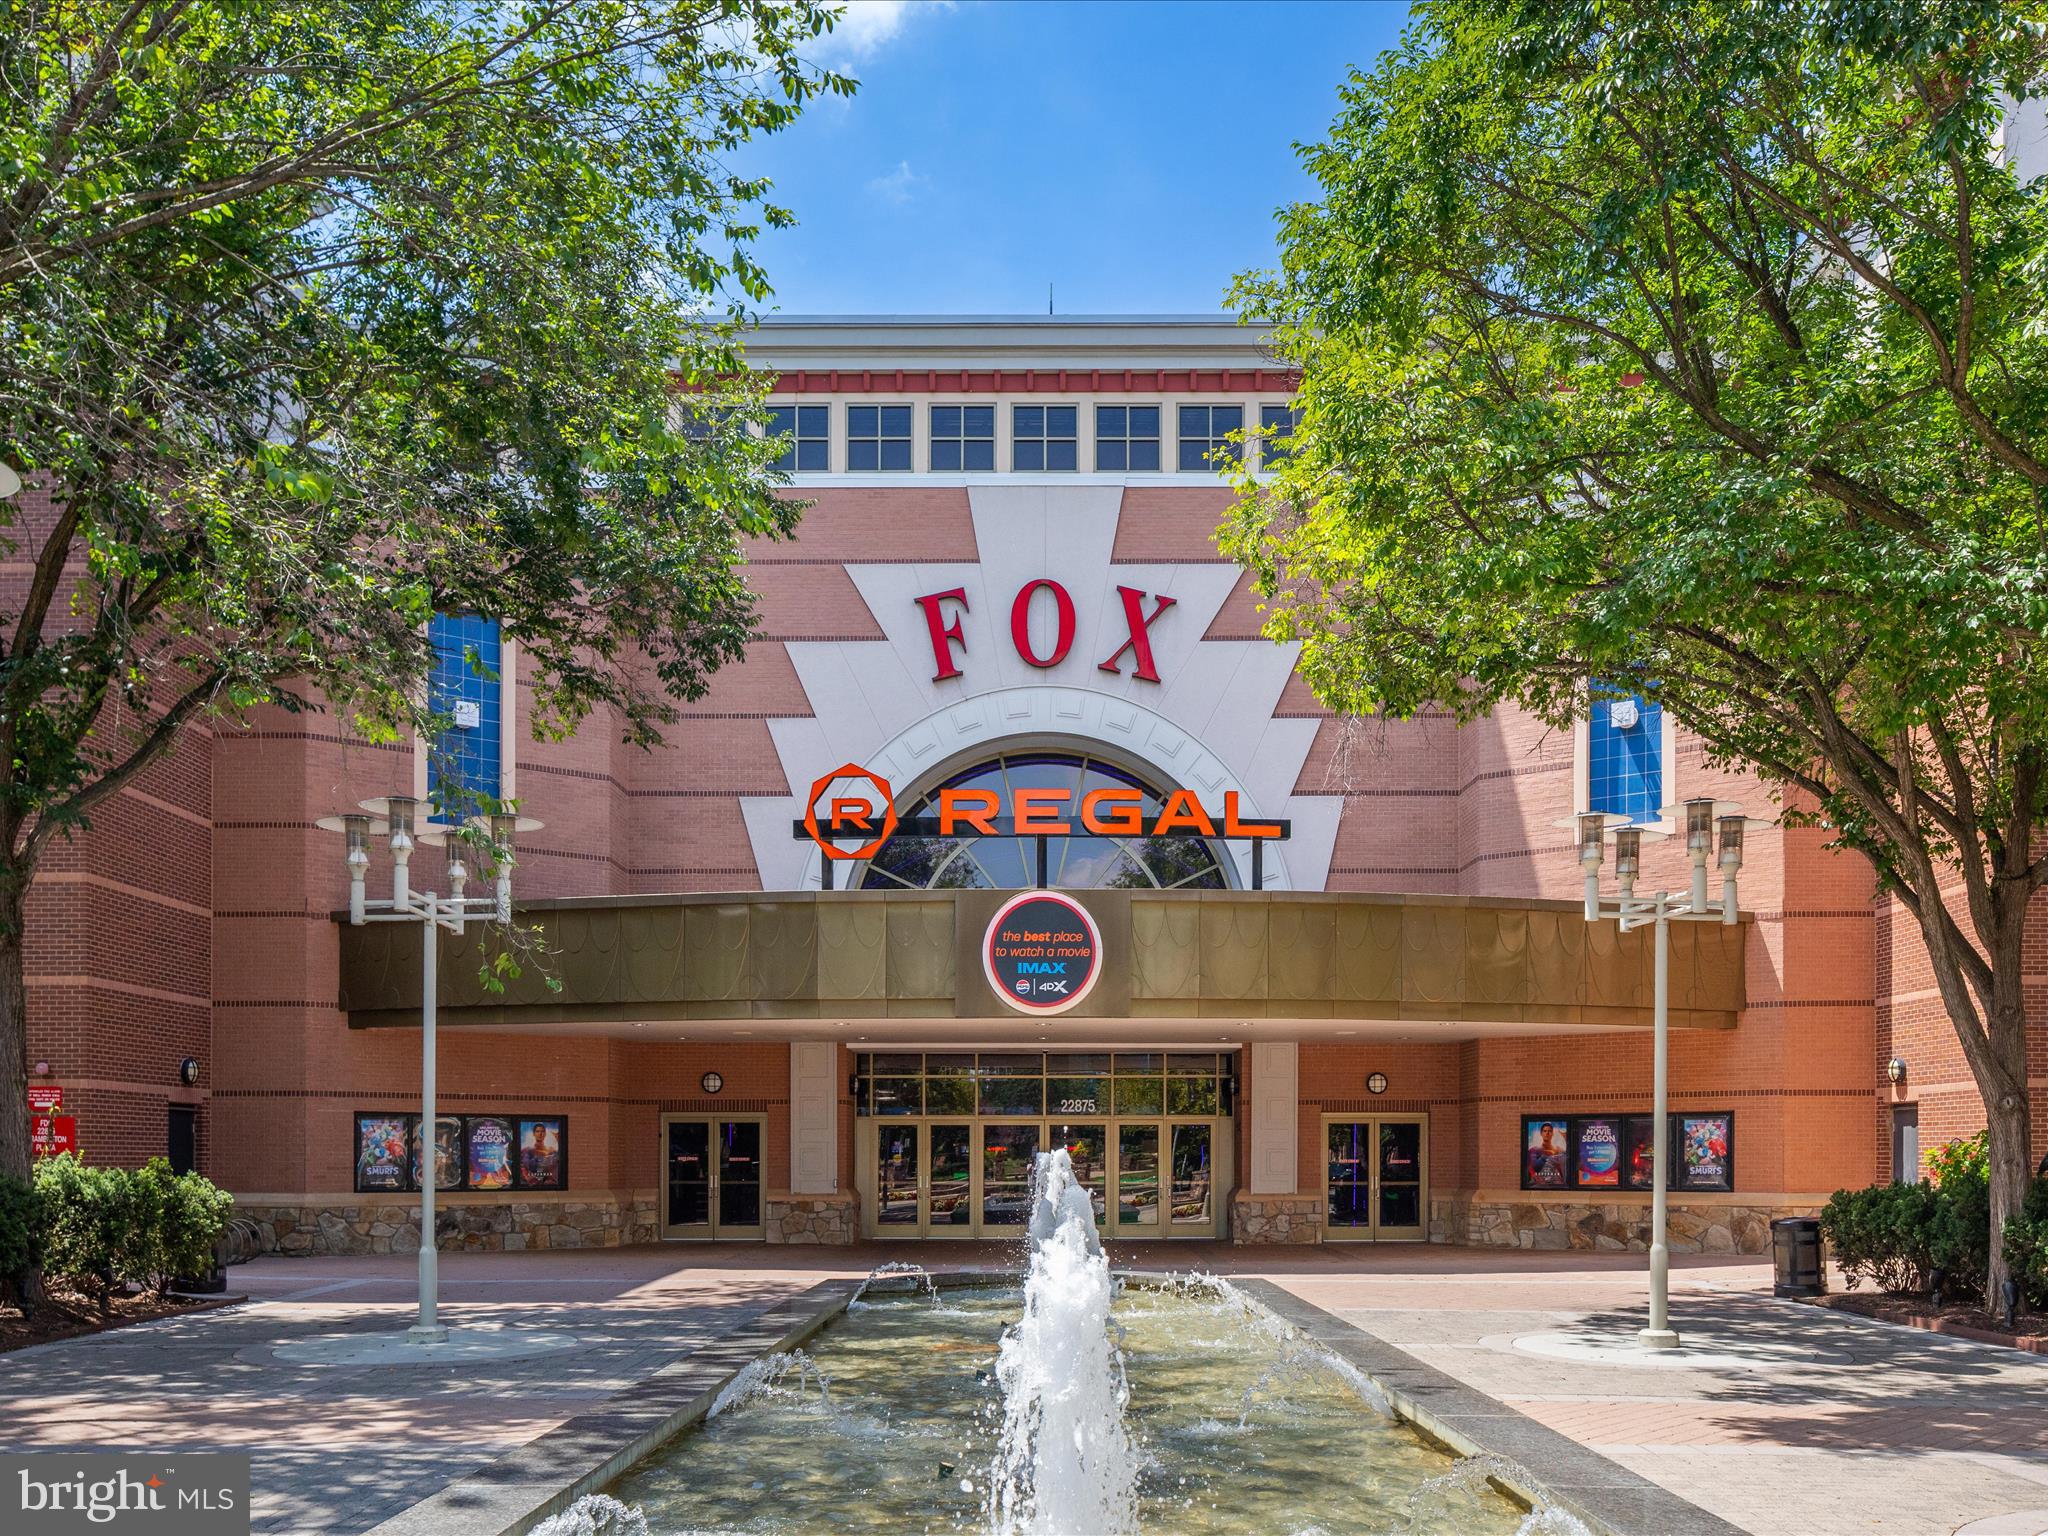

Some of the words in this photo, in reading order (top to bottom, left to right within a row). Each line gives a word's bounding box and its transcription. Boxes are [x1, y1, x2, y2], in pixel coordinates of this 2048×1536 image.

[914, 578, 1178, 684] FOX
[939, 787, 1283, 838] REGAL
[1002, 930, 1022, 942] the
[1023, 930, 1050, 942] best
[1052, 930, 1084, 944] place
[995, 946, 1007, 957] to
[1010, 946, 1044, 957] watch
[1047, 948, 1055, 957] a
[1056, 946, 1091, 957] movie
[1017, 962, 1066, 974] IMAX
[1039, 980, 1069, 994] 4DX
[1060, 1099, 1096, 1112] 22875
[37, 1127, 56, 1135] 2285
[1586, 1128, 1612, 1136] MOVIE
[472, 1135, 506, 1143] SEASON
[1582, 1135, 1616, 1143] SEASON
[36, 1143, 57, 1151] PLA
[366, 1166, 400, 1176] SMURFS
[1689, 1166, 1723, 1175] SMURFS
